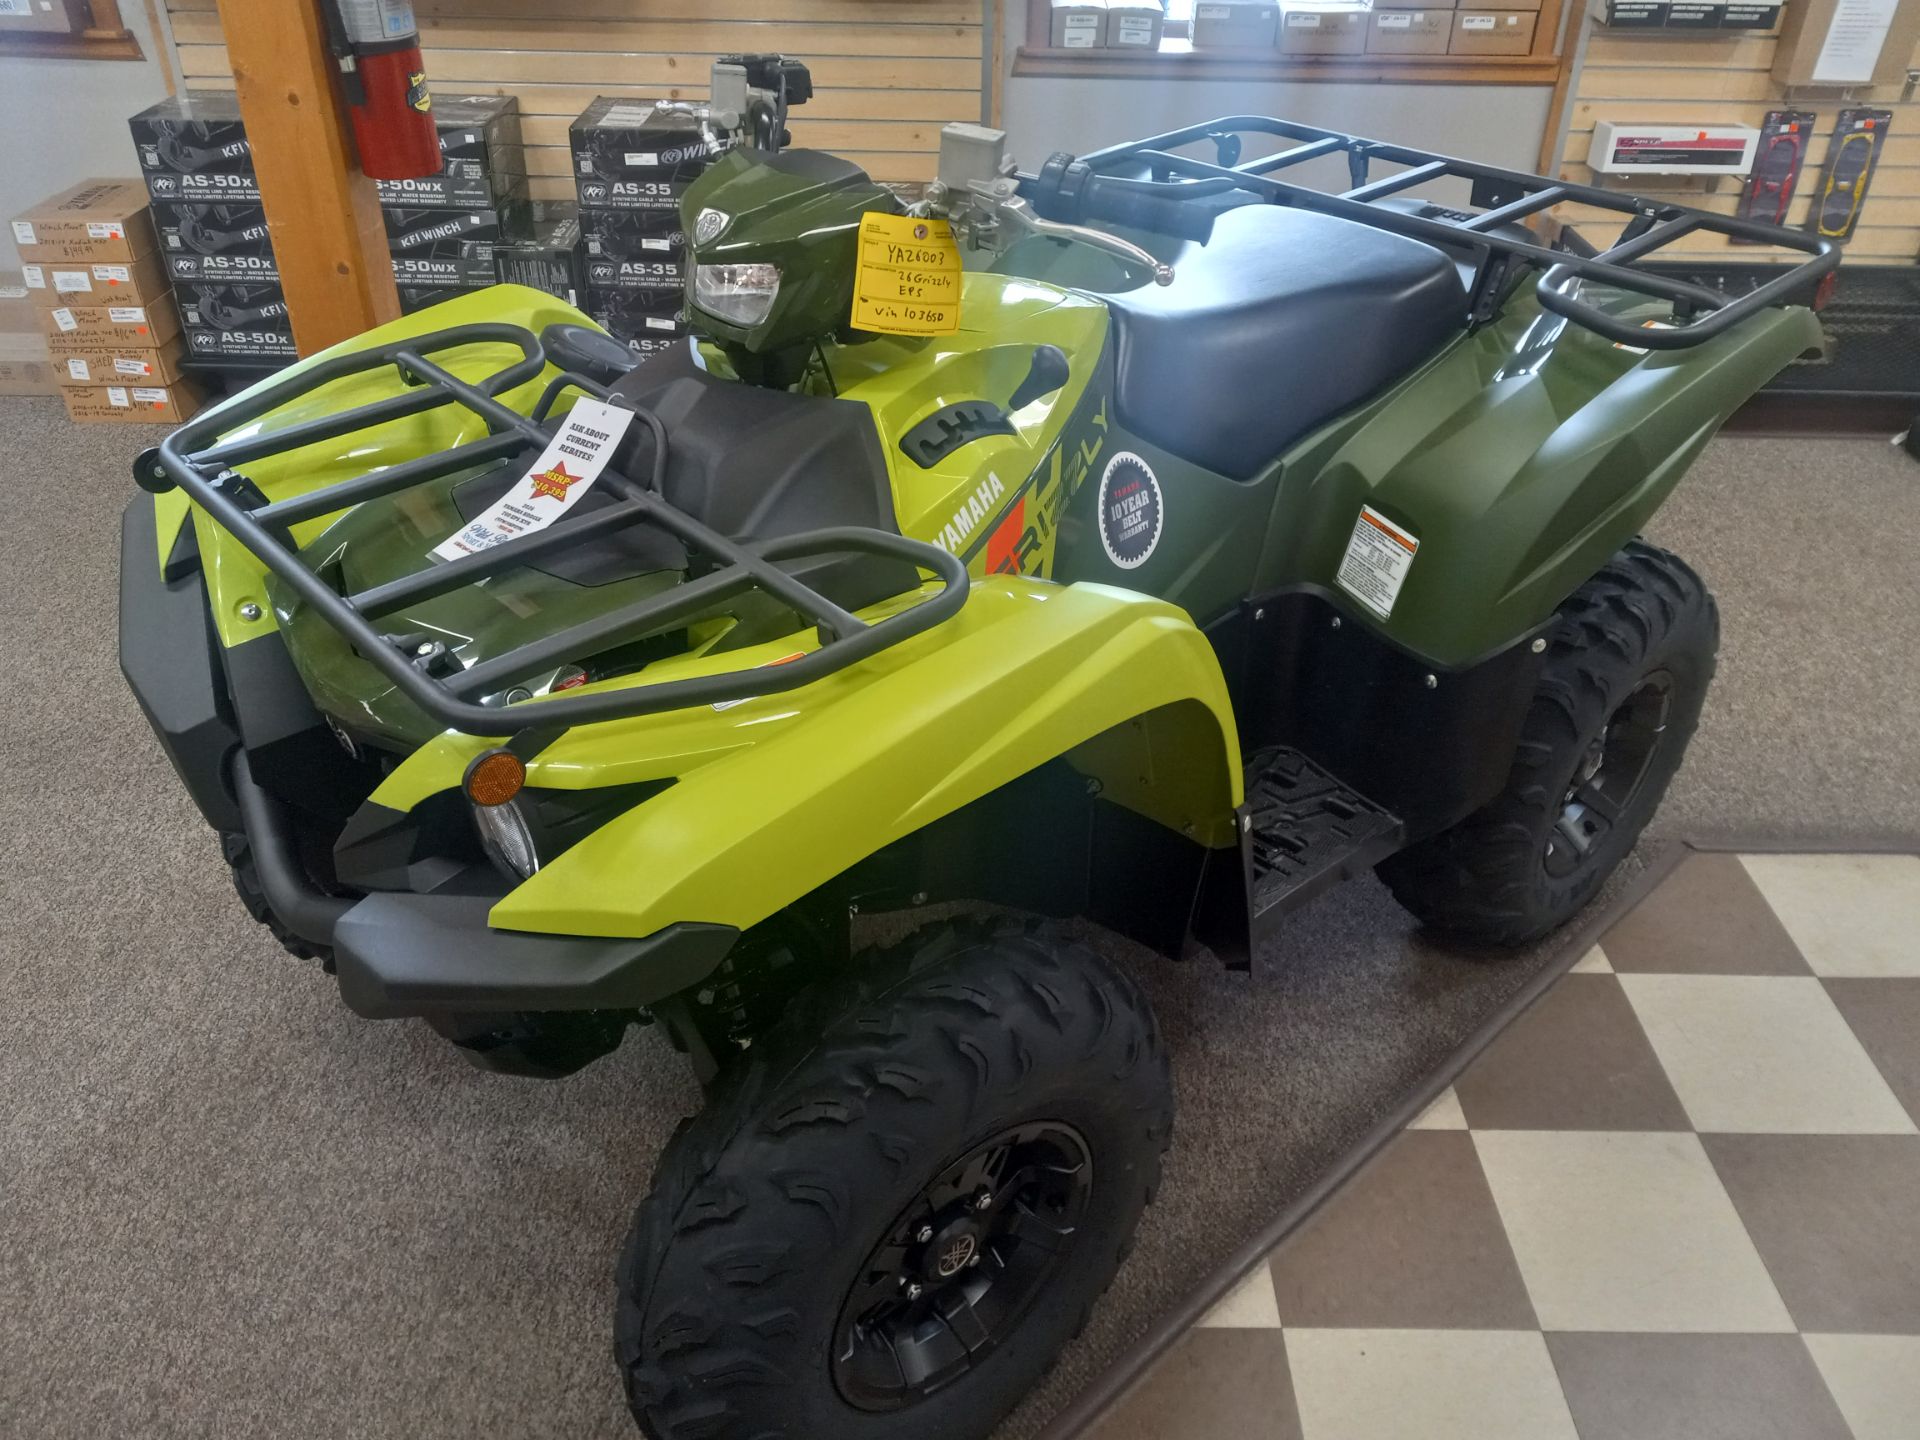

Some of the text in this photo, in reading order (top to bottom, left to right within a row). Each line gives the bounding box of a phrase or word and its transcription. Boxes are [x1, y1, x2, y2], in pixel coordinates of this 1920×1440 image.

[611, 182, 672, 196] AS-35
[401, 221, 462, 248] KFI WINCH
[620, 262, 678, 276] AS-35
[899, 285, 924, 298] EPS
[628, 339, 677, 351] AS-3
[90, 354, 113, 370] SHED
[569, 422, 611, 442] ASK ABOUT
[565, 434, 602, 452] CURRENT
[557, 444, 596, 463] REBATES!
[544, 469, 574, 487] MSRP:
[931, 470, 1006, 553] YAMAHA
[1122, 509, 1142, 530] BELT
[1118, 519, 1149, 542] WARRANTY
